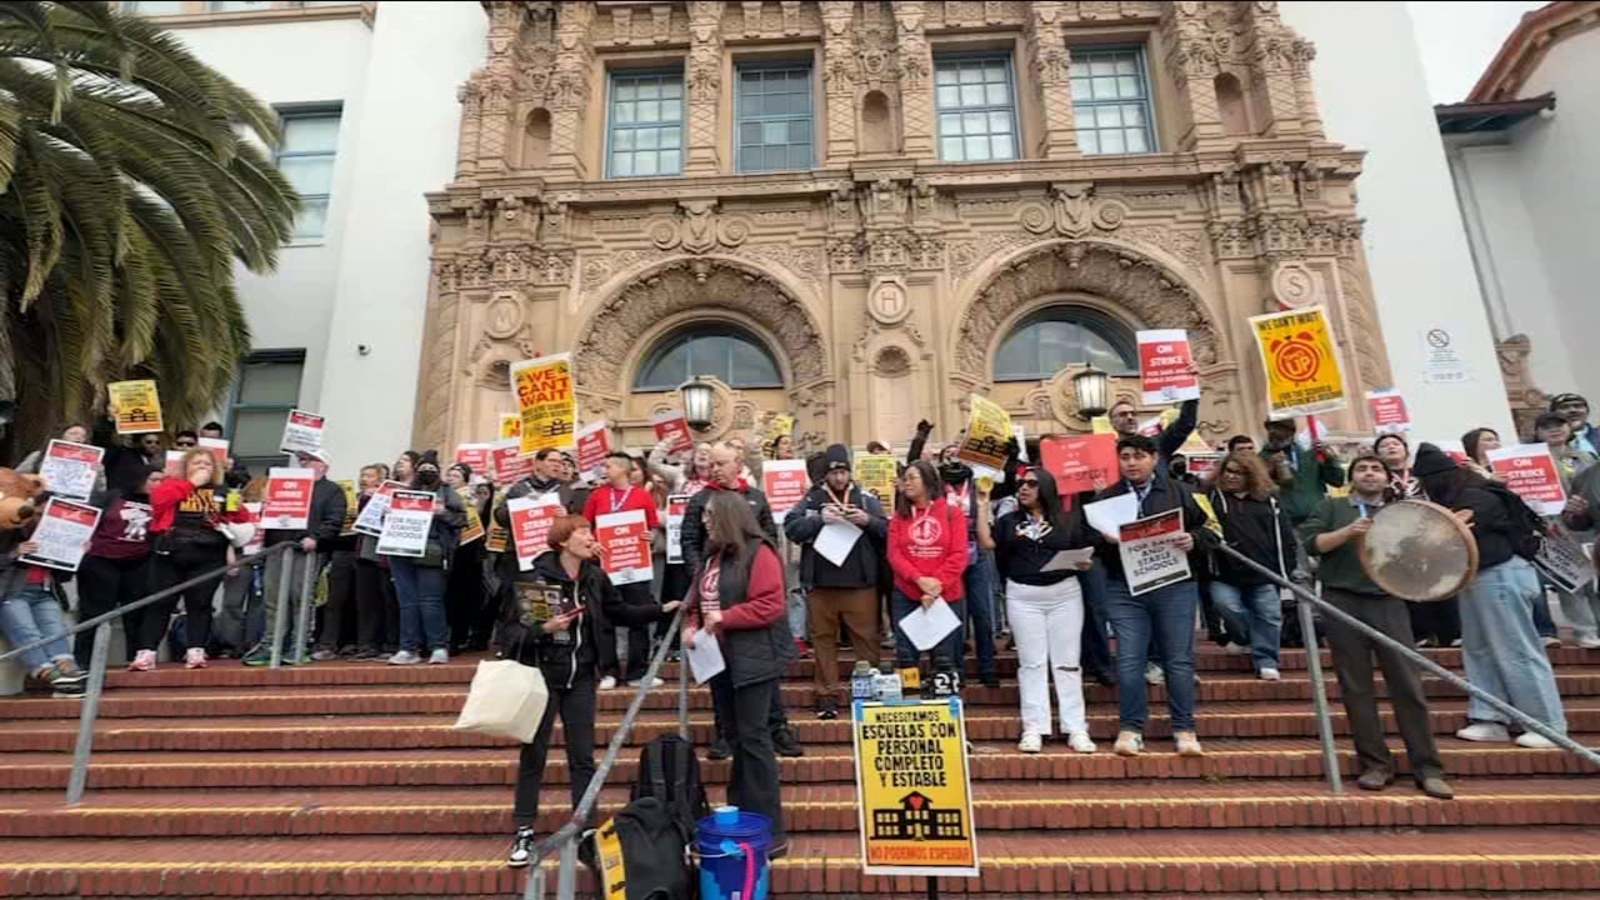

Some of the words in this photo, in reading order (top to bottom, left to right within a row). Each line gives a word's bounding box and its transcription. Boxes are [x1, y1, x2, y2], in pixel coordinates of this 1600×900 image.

[881, 290, 896, 311] H
[1156, 345, 1173, 354] ON
[1149, 355, 1184, 367] STRIKE
[527, 369, 554, 382] WE
[520, 390, 567, 408] WAIT
[1513, 459, 1532, 467] ON
[1507, 468, 1546, 480] STRIKE
[283, 481, 297, 489] ON
[527, 508, 545, 518] ON
[614, 526, 630, 535] ON
[608, 537, 639, 548] STRIKE
[1128, 543, 1147, 552] FOR
[1142, 547, 1164, 556] AND
[1138, 552, 1170, 566] STABLE
[1133, 558, 1179, 577] SCHOOLS
[876, 711, 939, 723] NECESITAMOS
[863, 724, 924, 740] ESCUELAS
[930, 722, 956, 738] CON
[877, 739, 943, 755] PERSONAL
[874, 755, 944, 771] COMPLETO
[879, 772, 886, 787] Y
[892, 771, 946, 787] ESTABLE
[870, 846, 881, 860] NO
[884, 846, 926, 860] PODEMOS
[929, 846, 970, 861] ESPERAR
